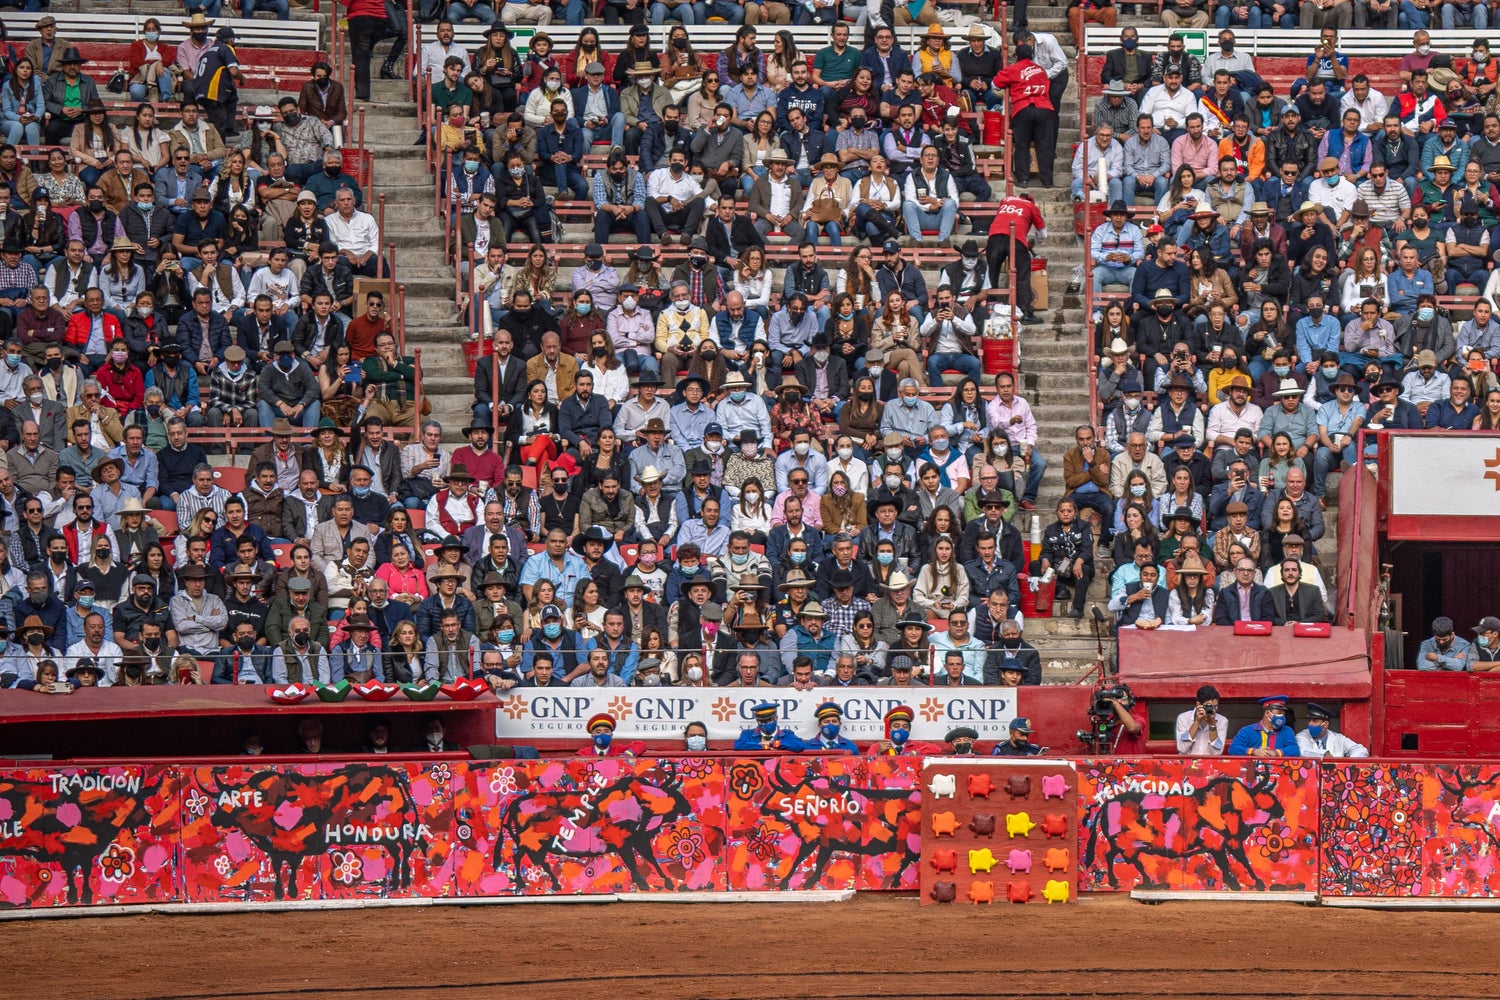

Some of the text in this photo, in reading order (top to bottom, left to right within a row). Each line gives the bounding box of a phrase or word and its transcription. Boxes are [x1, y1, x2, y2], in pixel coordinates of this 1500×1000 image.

[1023, 85, 1046, 96] 477
[998, 204, 1024, 216] 264
[531, 696, 591, 718] GNP
[635, 698, 695, 719] GNP
[947, 699, 1006, 720] GNP
[530, 722, 583, 730] SEGURO
[48, 771, 140, 795] TRADICIÓN
[1093, 779, 1195, 805] TENACIDAD
[218, 790, 263, 808] ARTE
[779, 790, 860, 816] SEÑORÍO
[552, 772, 608, 852] TEMPLE
[324, 823, 434, 843] HONDURA
